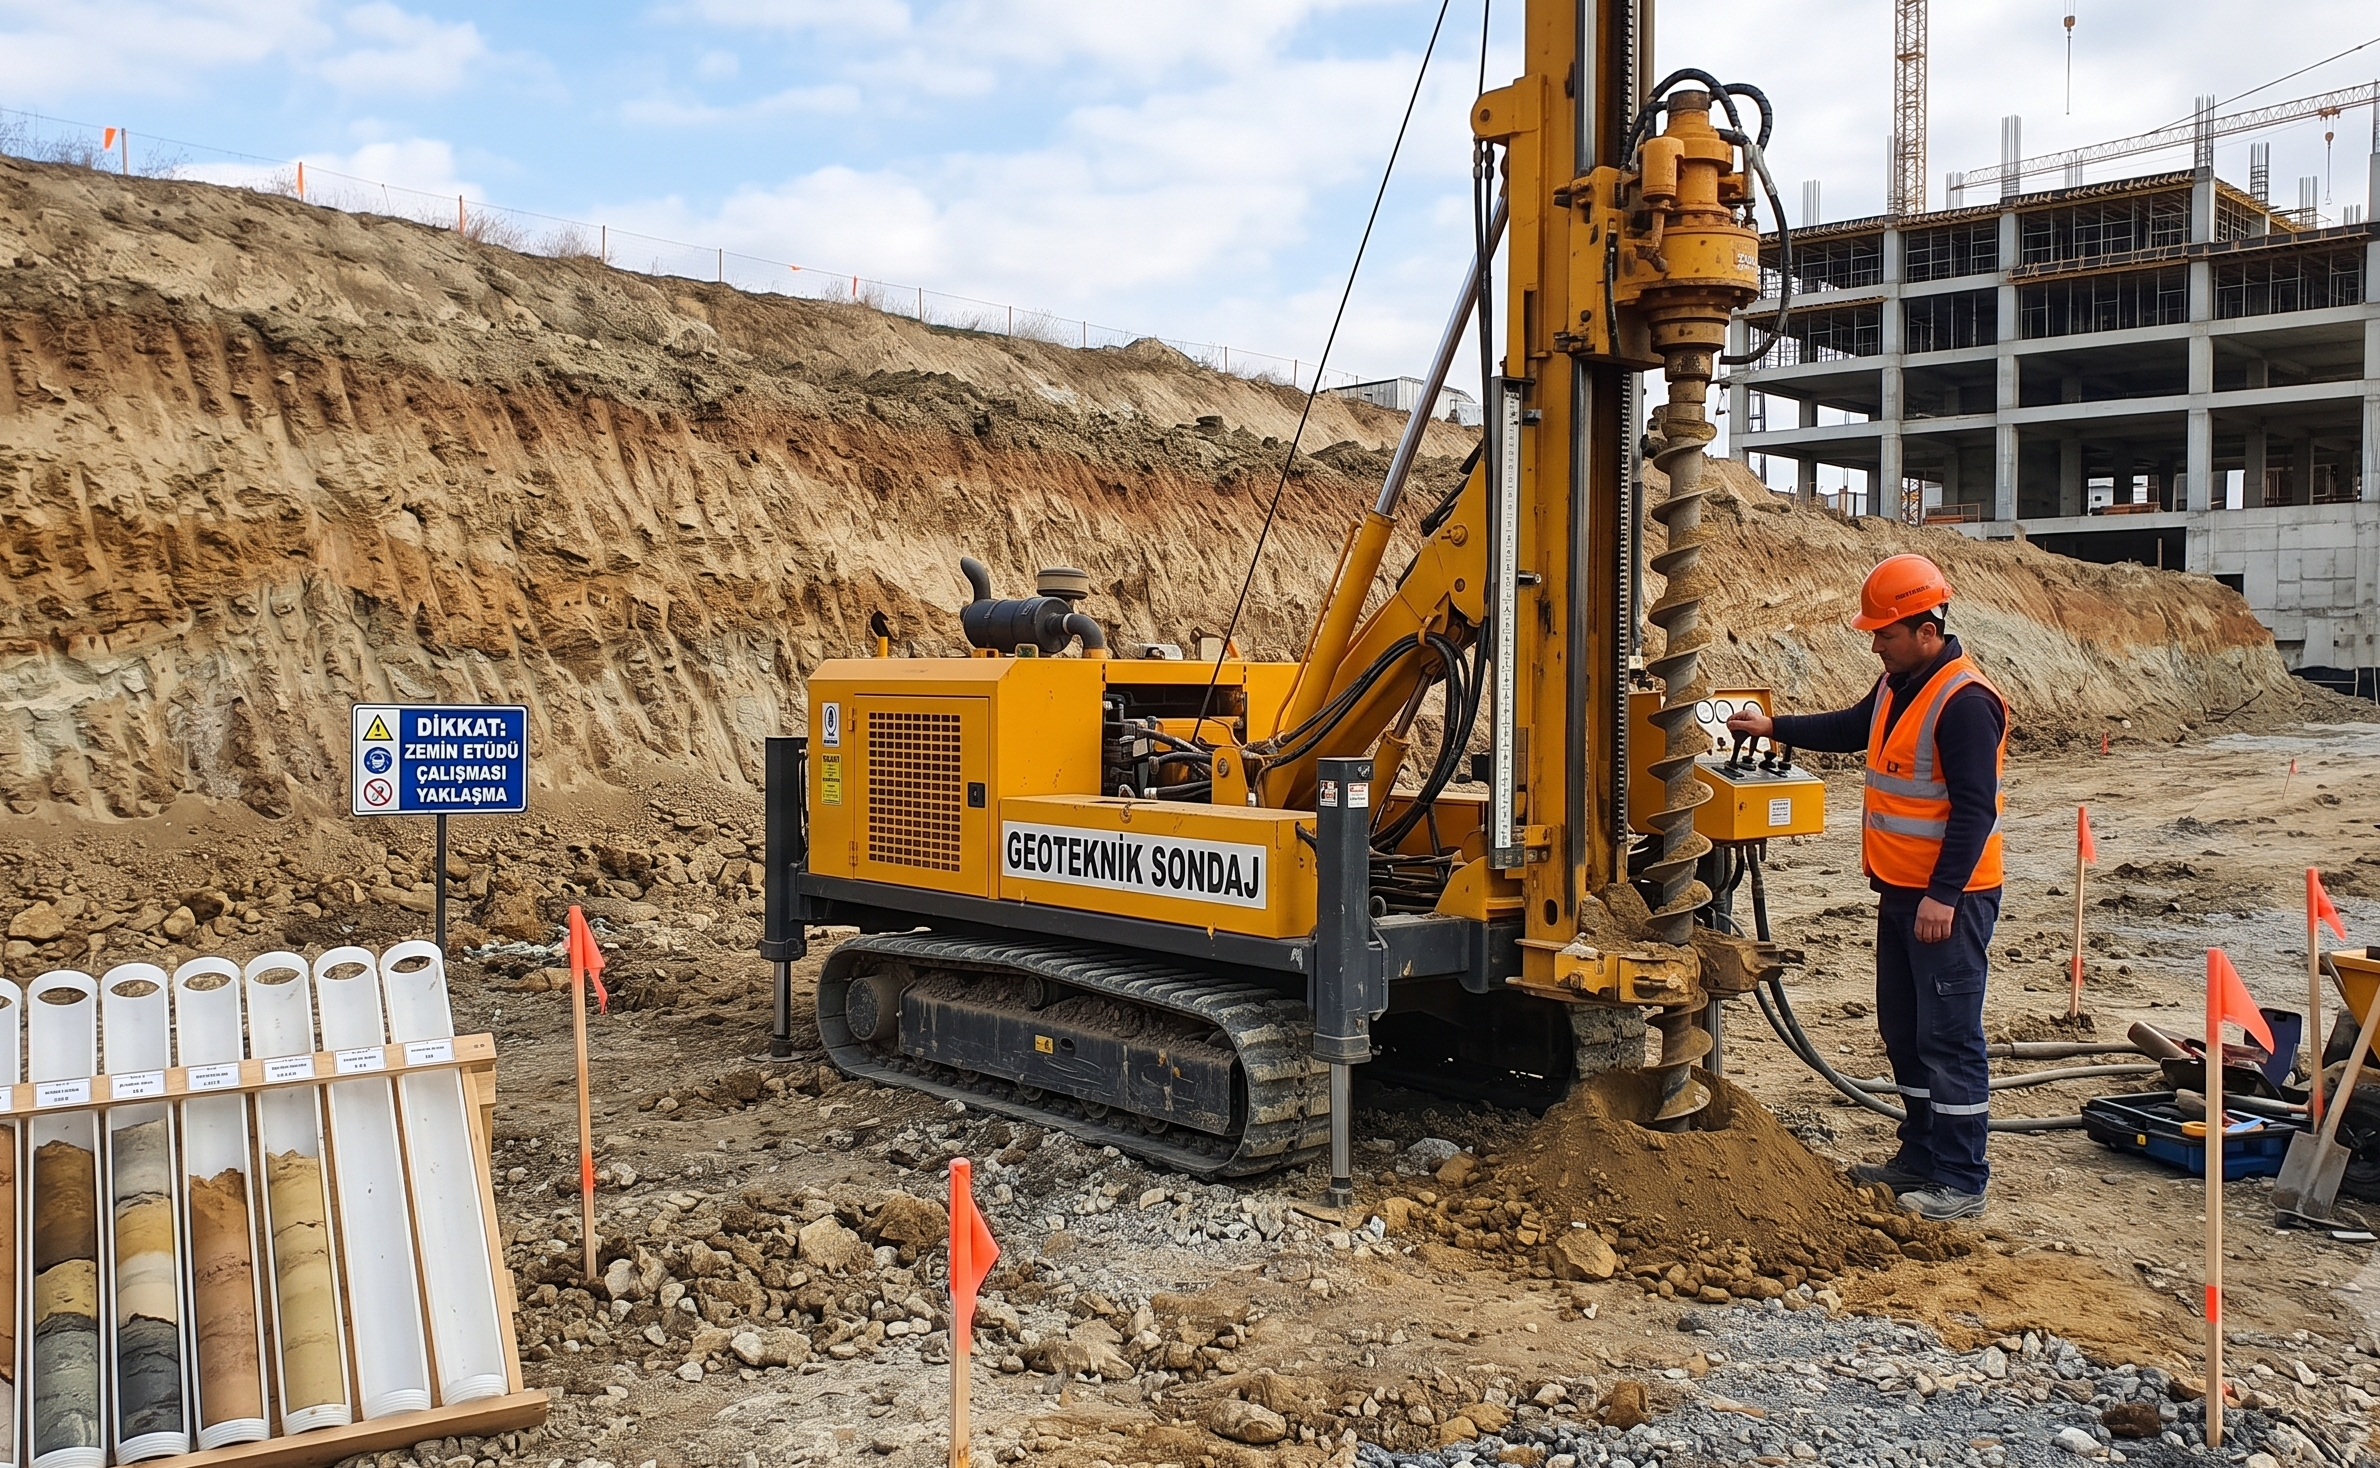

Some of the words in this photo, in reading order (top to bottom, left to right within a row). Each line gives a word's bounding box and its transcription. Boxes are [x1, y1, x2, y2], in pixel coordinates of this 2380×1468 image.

[417, 714, 506, 737] DİKKAT:
[404, 740, 458, 759] ZEMİN
[463, 741, 519, 759] ETÜDÜ
[416, 766, 507, 784] ÇALIŞMASI
[416, 787, 508, 805] YAKLAŞMA
[1007, 831, 1144, 885] GEOTEKNİK
[1151, 845, 1260, 899] SONDAJ
